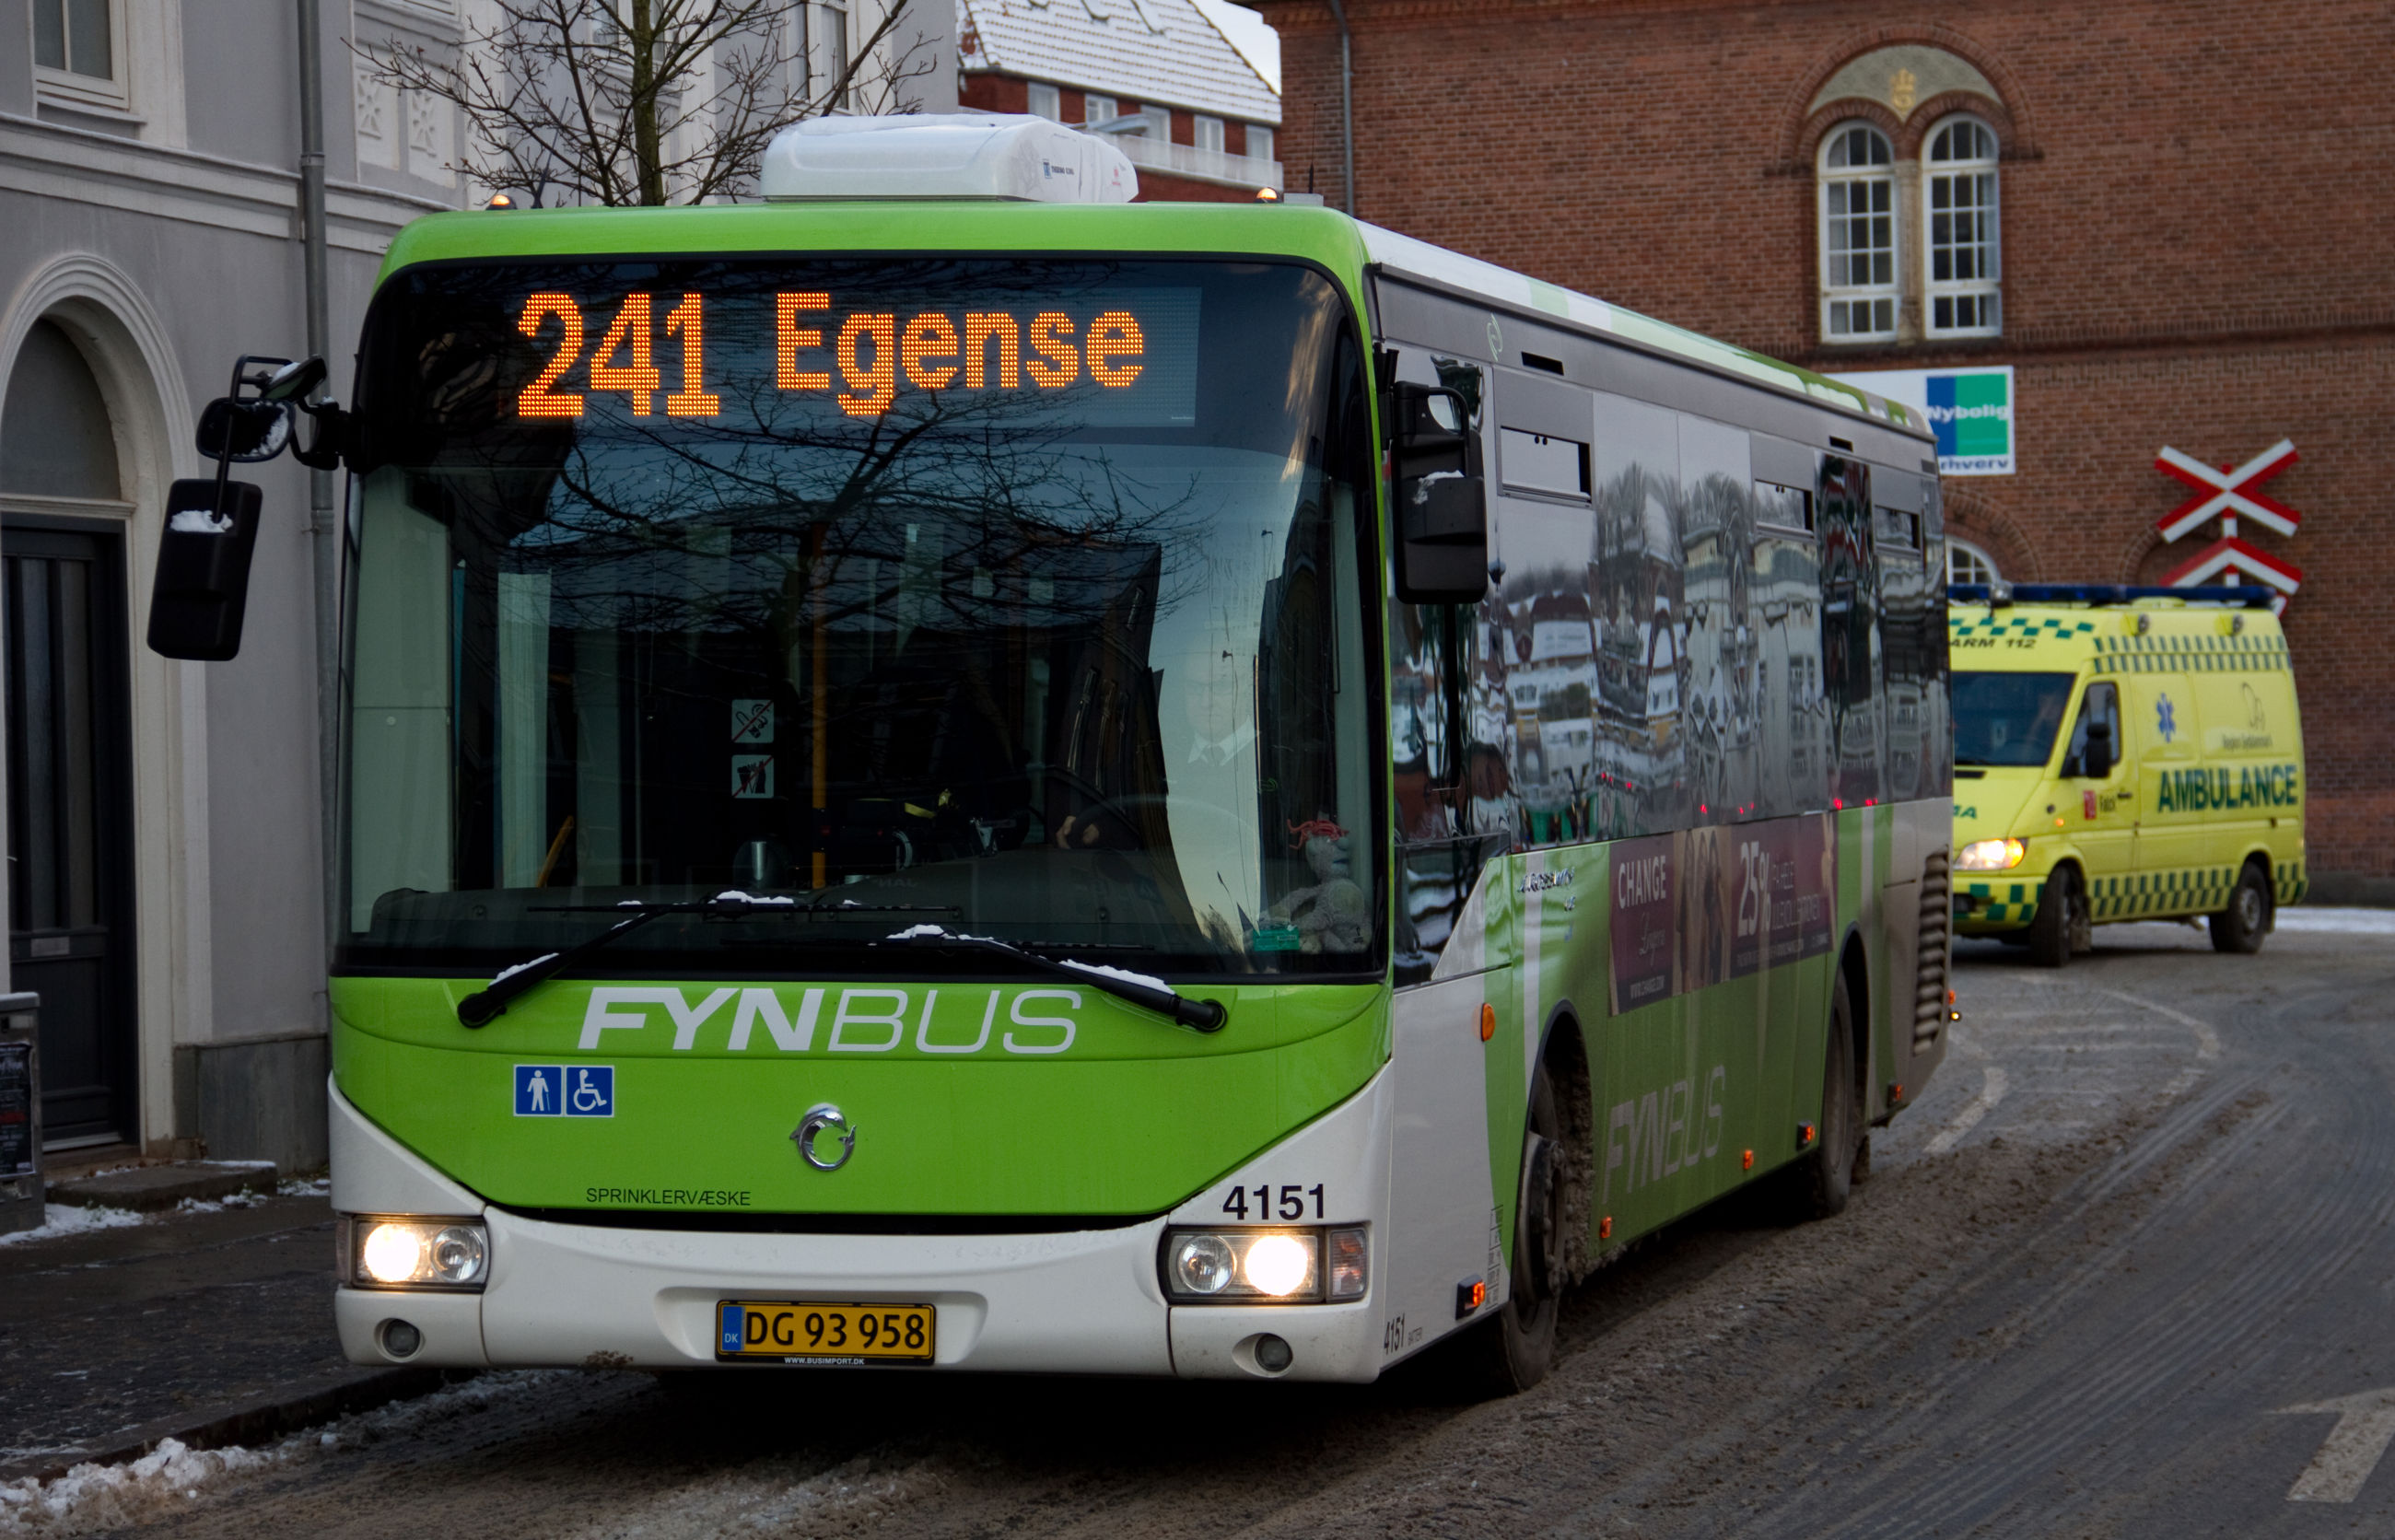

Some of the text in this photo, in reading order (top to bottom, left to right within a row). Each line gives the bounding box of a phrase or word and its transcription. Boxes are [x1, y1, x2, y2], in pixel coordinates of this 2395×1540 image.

[517, 291, 1146, 418] 241 Egense
[2006, 637, 2037, 648] 112
[2158, 764, 2298, 813] AMBULANCE
[1618, 855, 1666, 909] CHANGE
[1737, 841, 1772, 938] 25%
[578, 986, 1082, 1055] FYNBUS
[1603, 1065, 1725, 1206] FYNBUS
[586, 1186, 752, 1207] SPRINKLERVÆSKE
[1222, 1184, 1325, 1220] 4151
[724, 1333, 739, 1344] DK
[745, 1311, 926, 1349] DG 93 958
[1384, 1312, 1406, 1356] 4151
[784, 1356, 865, 1366] WWW.BUSIMPORT.DK
